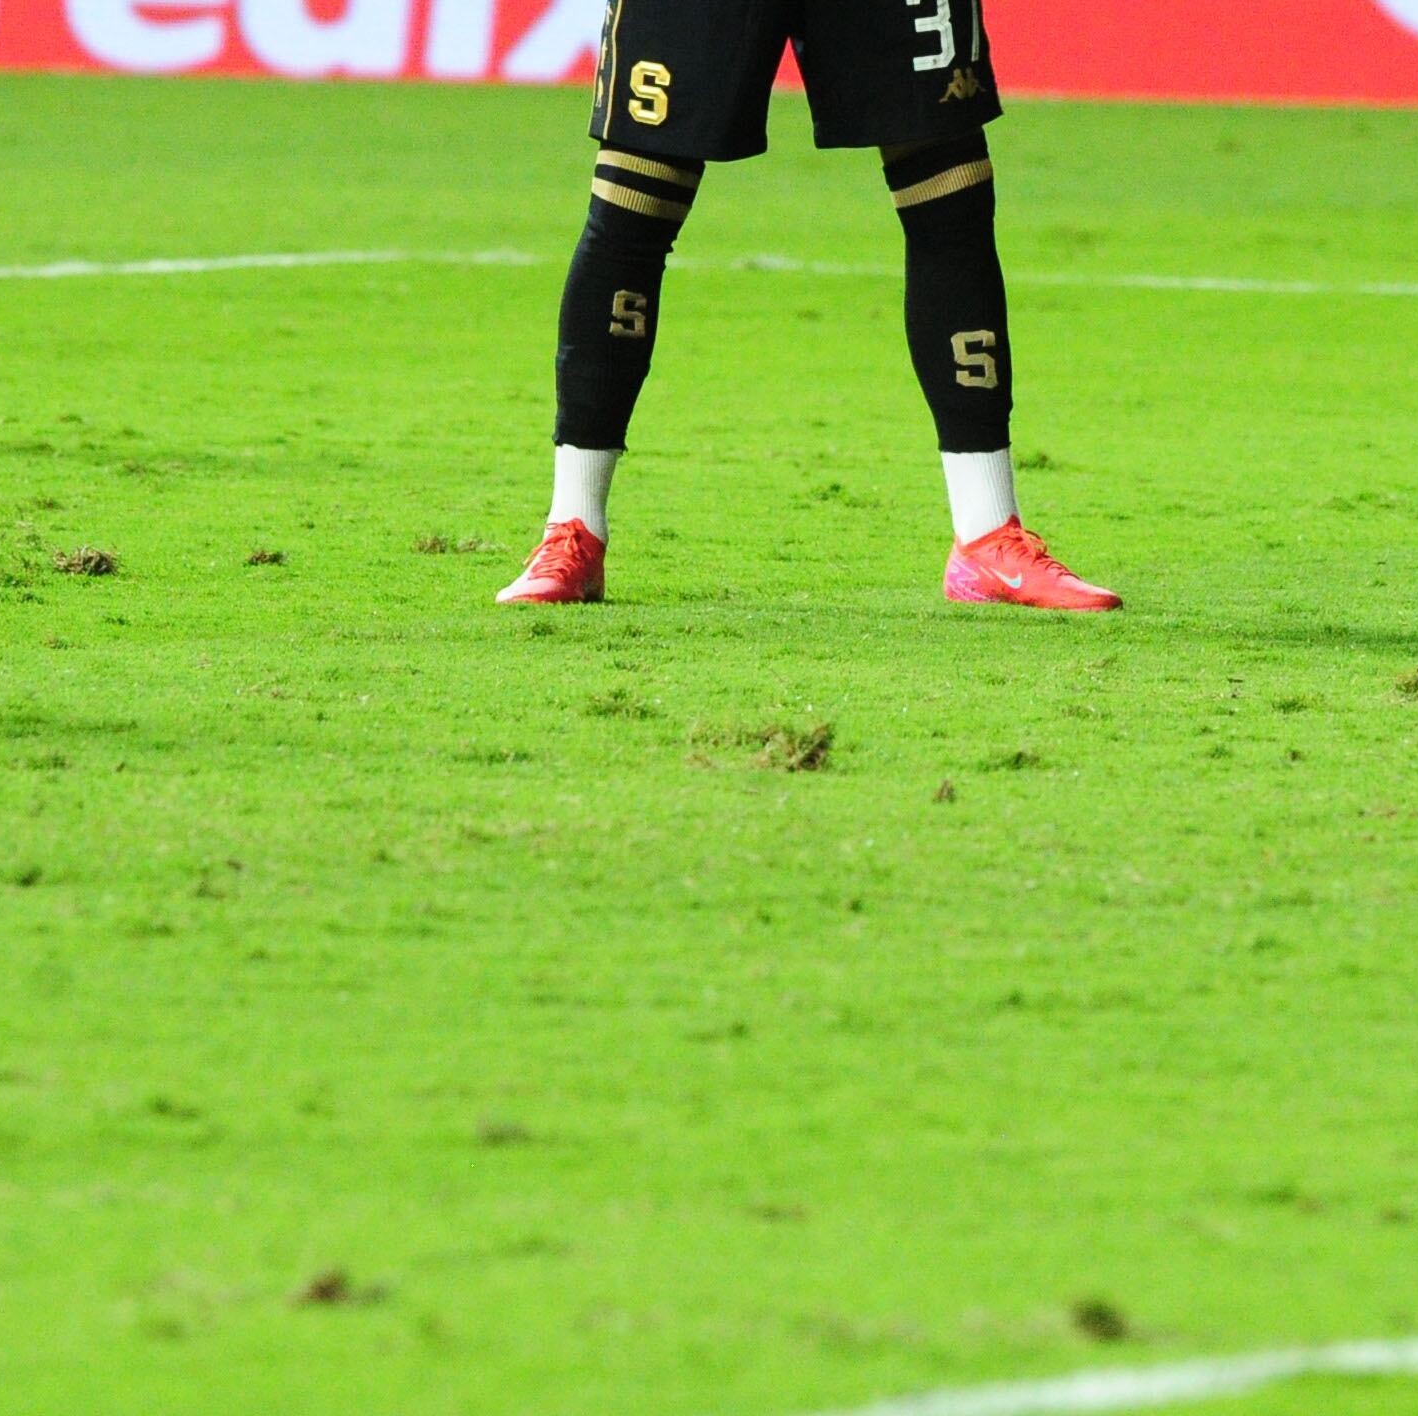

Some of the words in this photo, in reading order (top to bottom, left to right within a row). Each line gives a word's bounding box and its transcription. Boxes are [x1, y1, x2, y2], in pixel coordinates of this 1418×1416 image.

[628, 60, 672, 127] S
[609, 289, 647, 338] S
[949, 329, 998, 389] S
